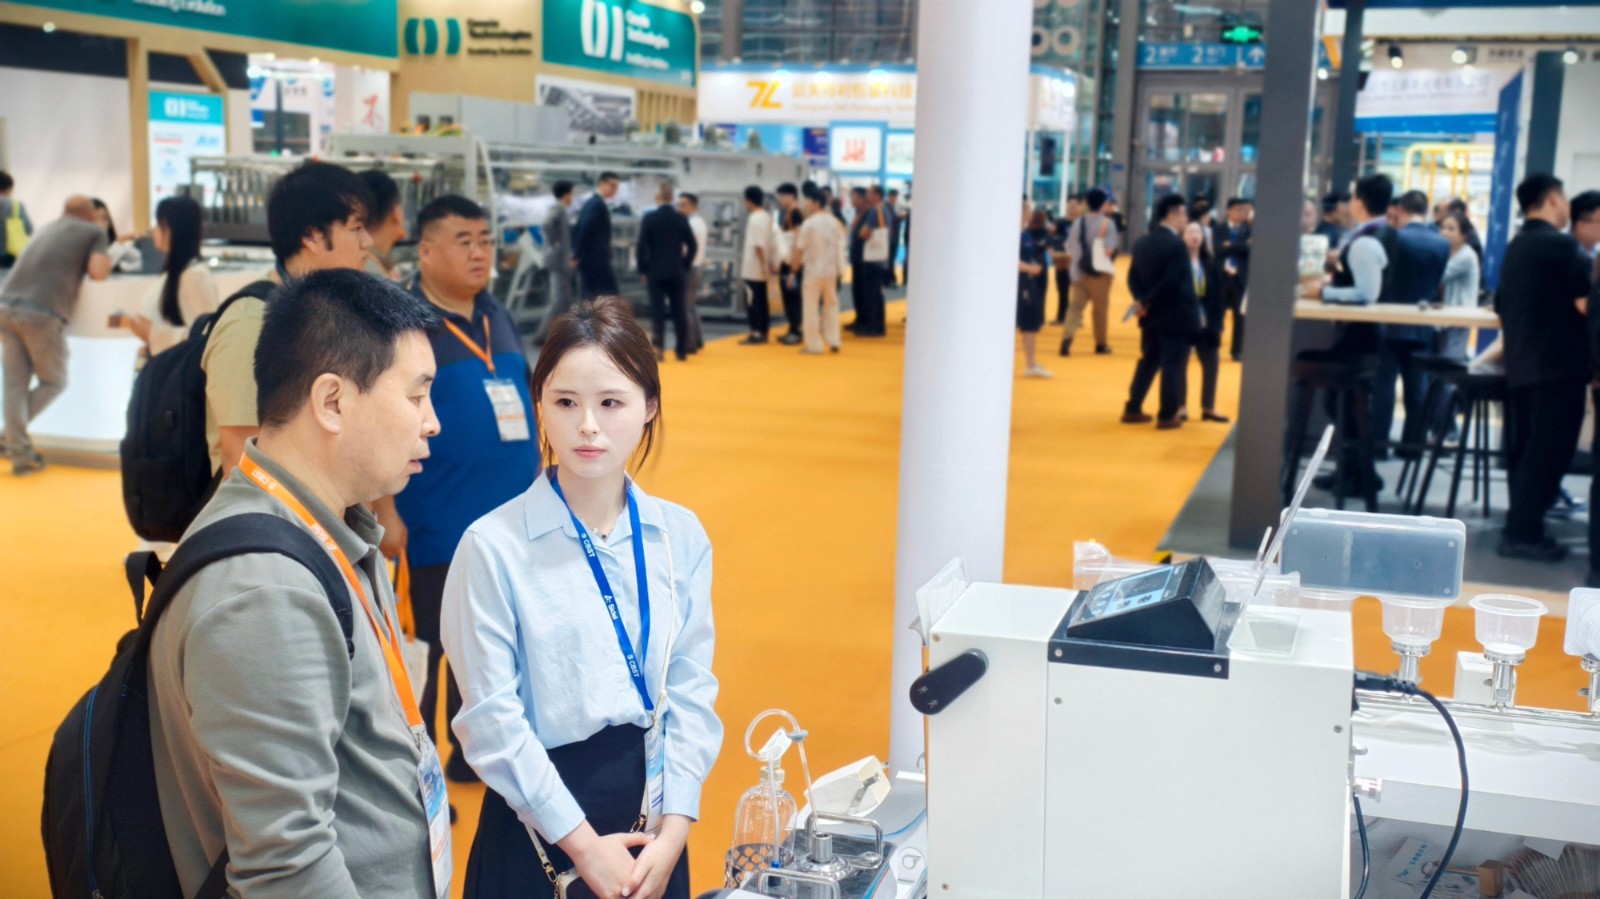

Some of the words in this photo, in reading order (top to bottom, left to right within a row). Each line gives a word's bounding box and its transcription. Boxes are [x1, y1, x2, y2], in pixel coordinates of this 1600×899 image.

[583, 538, 596, 559] CBST
[608, 603, 618, 621] Sidel
[629, 660, 640, 678] CBST
